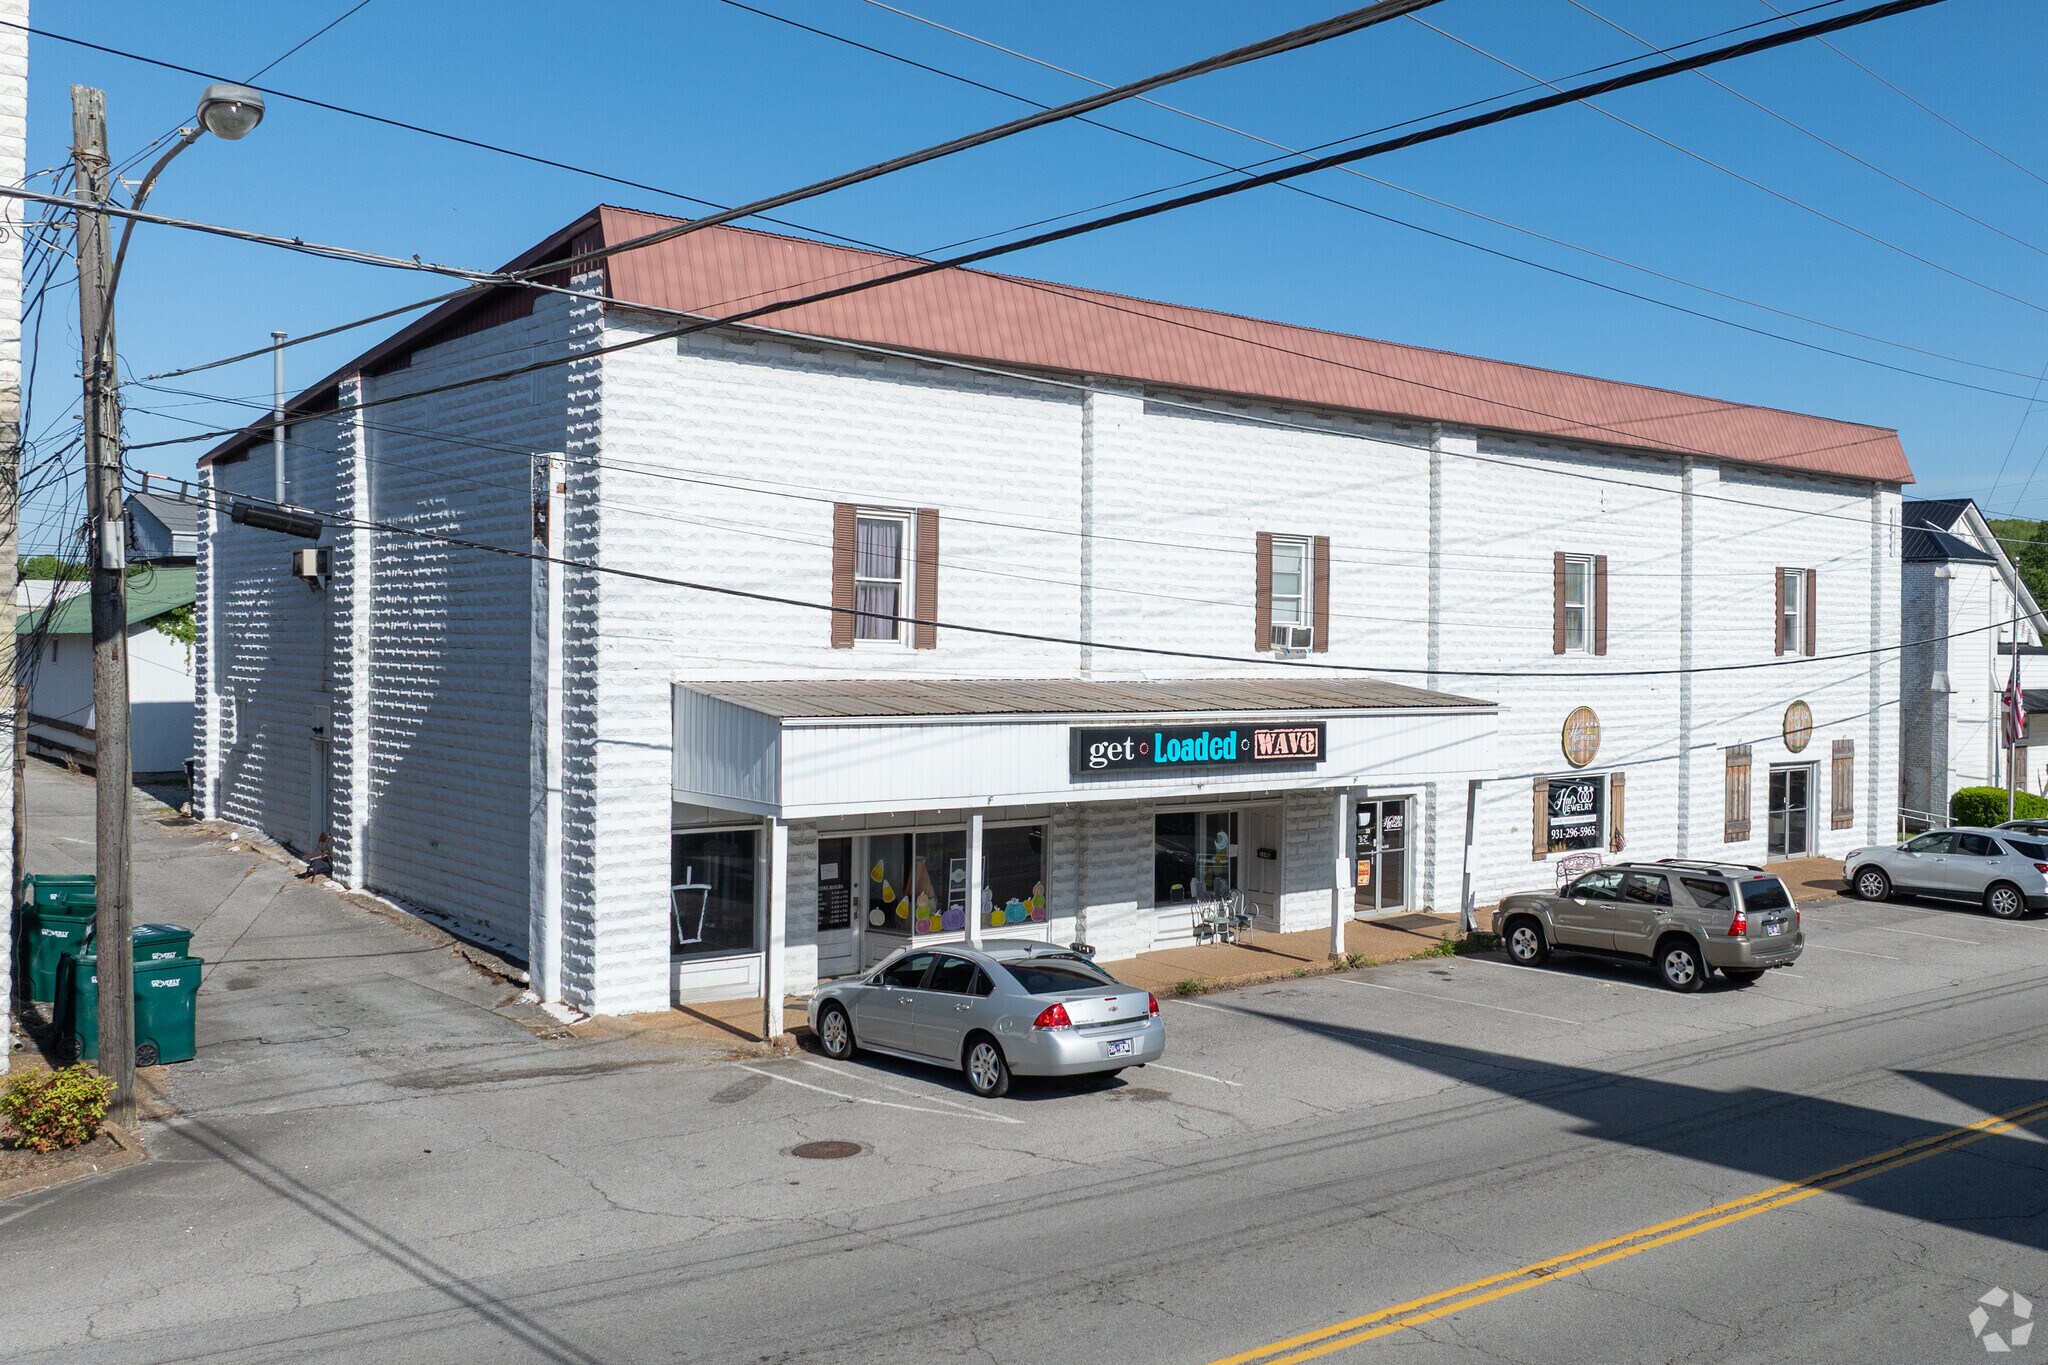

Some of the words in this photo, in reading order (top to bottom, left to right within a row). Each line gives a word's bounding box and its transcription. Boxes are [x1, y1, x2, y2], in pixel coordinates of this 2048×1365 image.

[1089, 736, 1135, 768] get
[1154, 730, 1238, 763] Loaded
[1257, 731, 1315, 755] WAVO
[1564, 803, 1593, 813] JEWELRY
[1551, 826, 1596, 840] 931-296-5965
